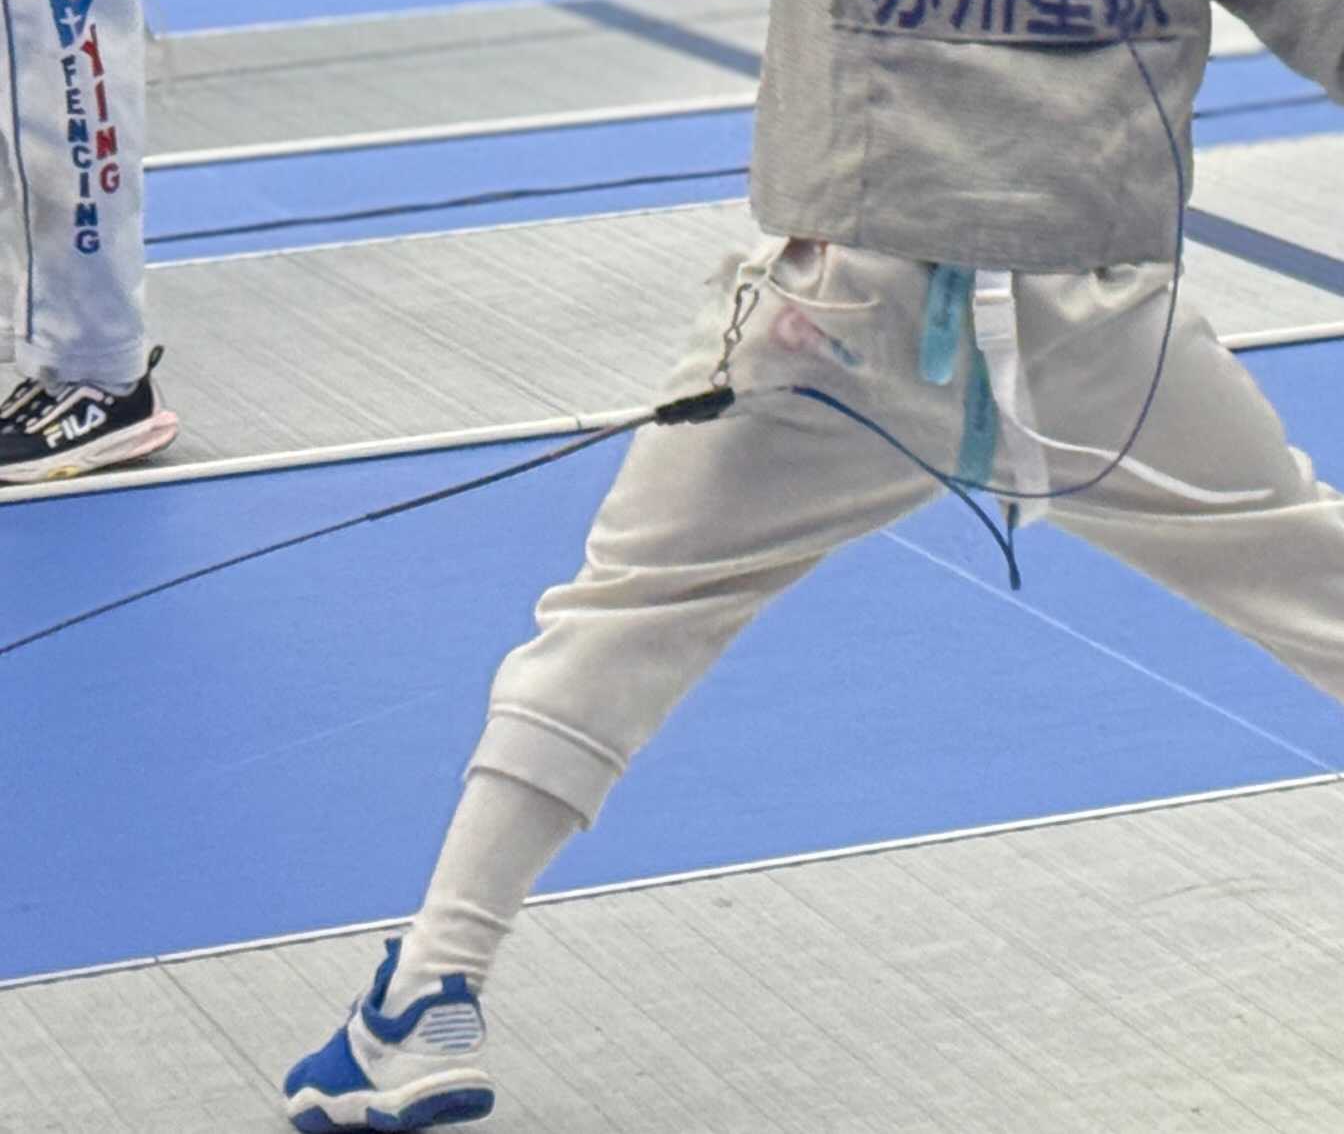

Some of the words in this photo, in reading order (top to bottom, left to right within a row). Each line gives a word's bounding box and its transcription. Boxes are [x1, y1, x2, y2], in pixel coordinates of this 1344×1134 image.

[60, 54, 101, 256] FENCING
[79, 23, 120, 194] YING
[44, 404, 106, 450] FILA
